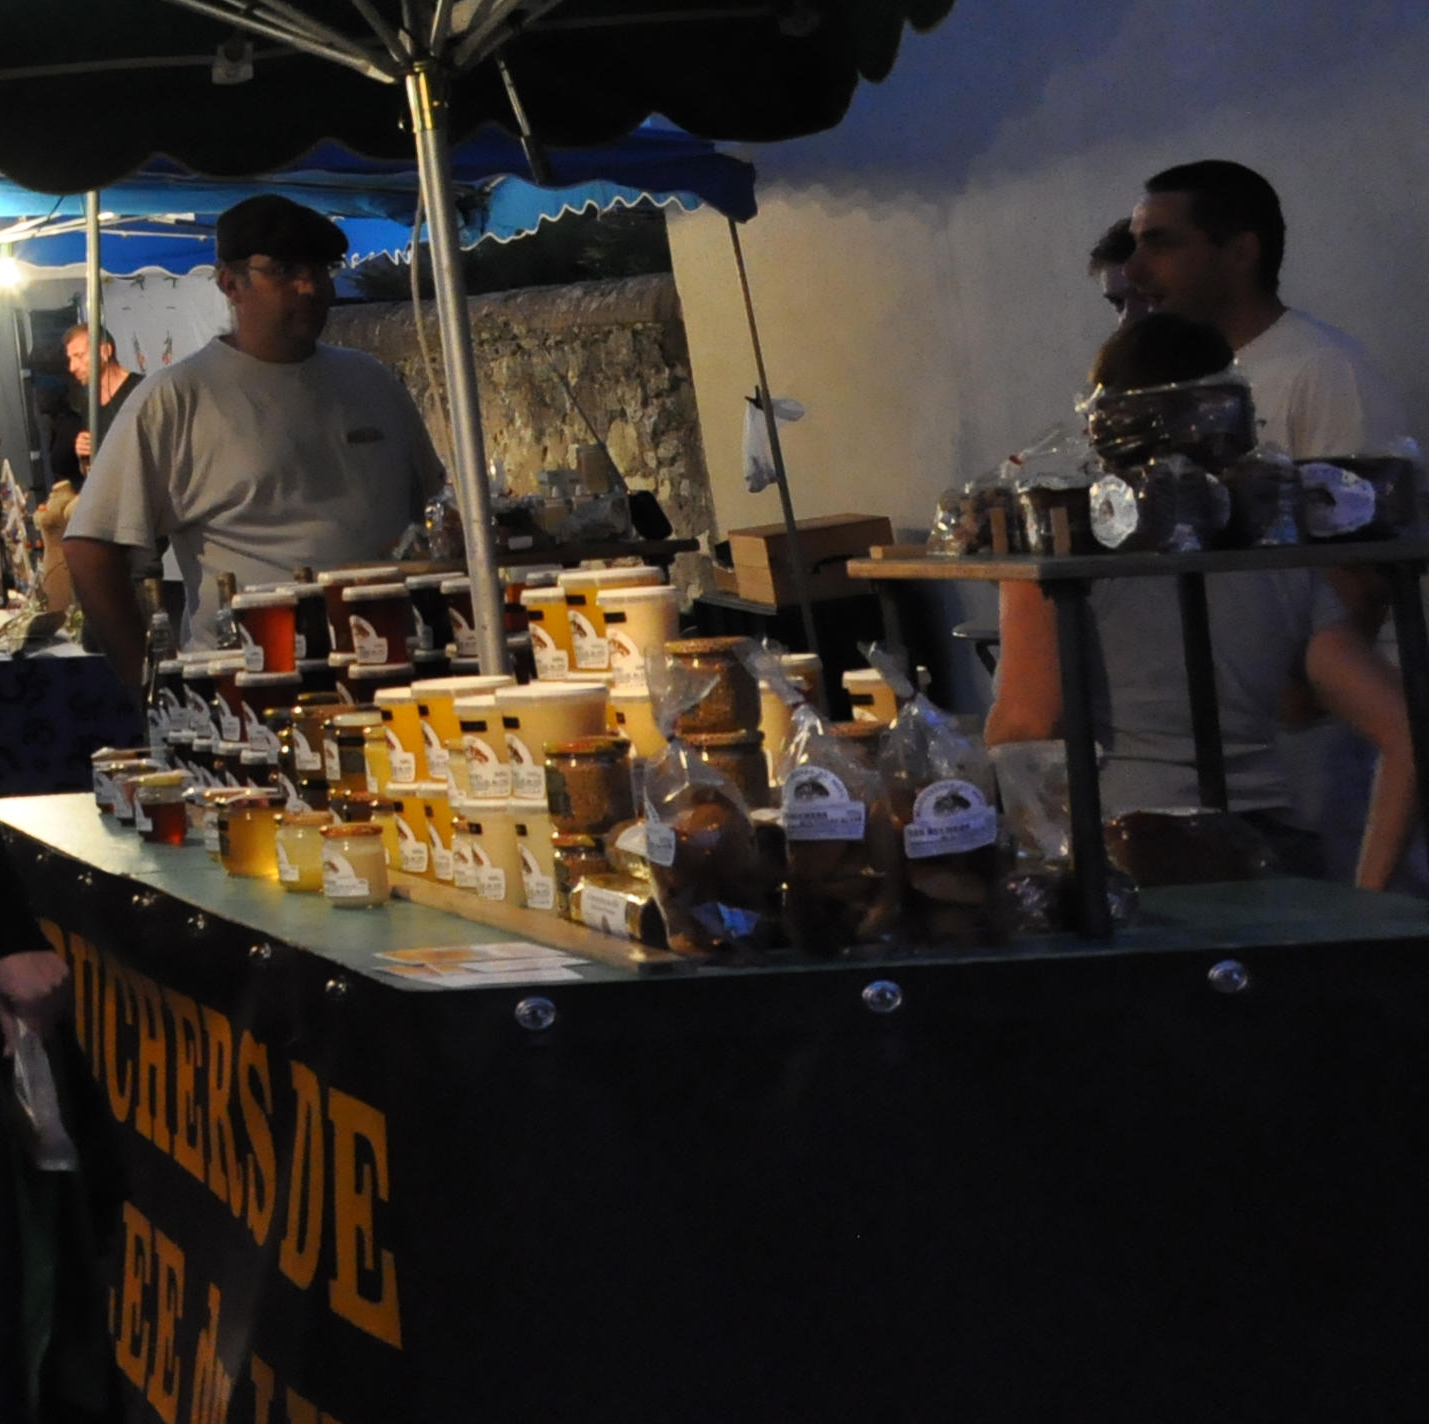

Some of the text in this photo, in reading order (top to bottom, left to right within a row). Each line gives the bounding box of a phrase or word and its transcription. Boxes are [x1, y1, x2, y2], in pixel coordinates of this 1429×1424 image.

[38, 917, 403, 1349] UCHERS DE
[108, 1201, 185, 1424] EE
